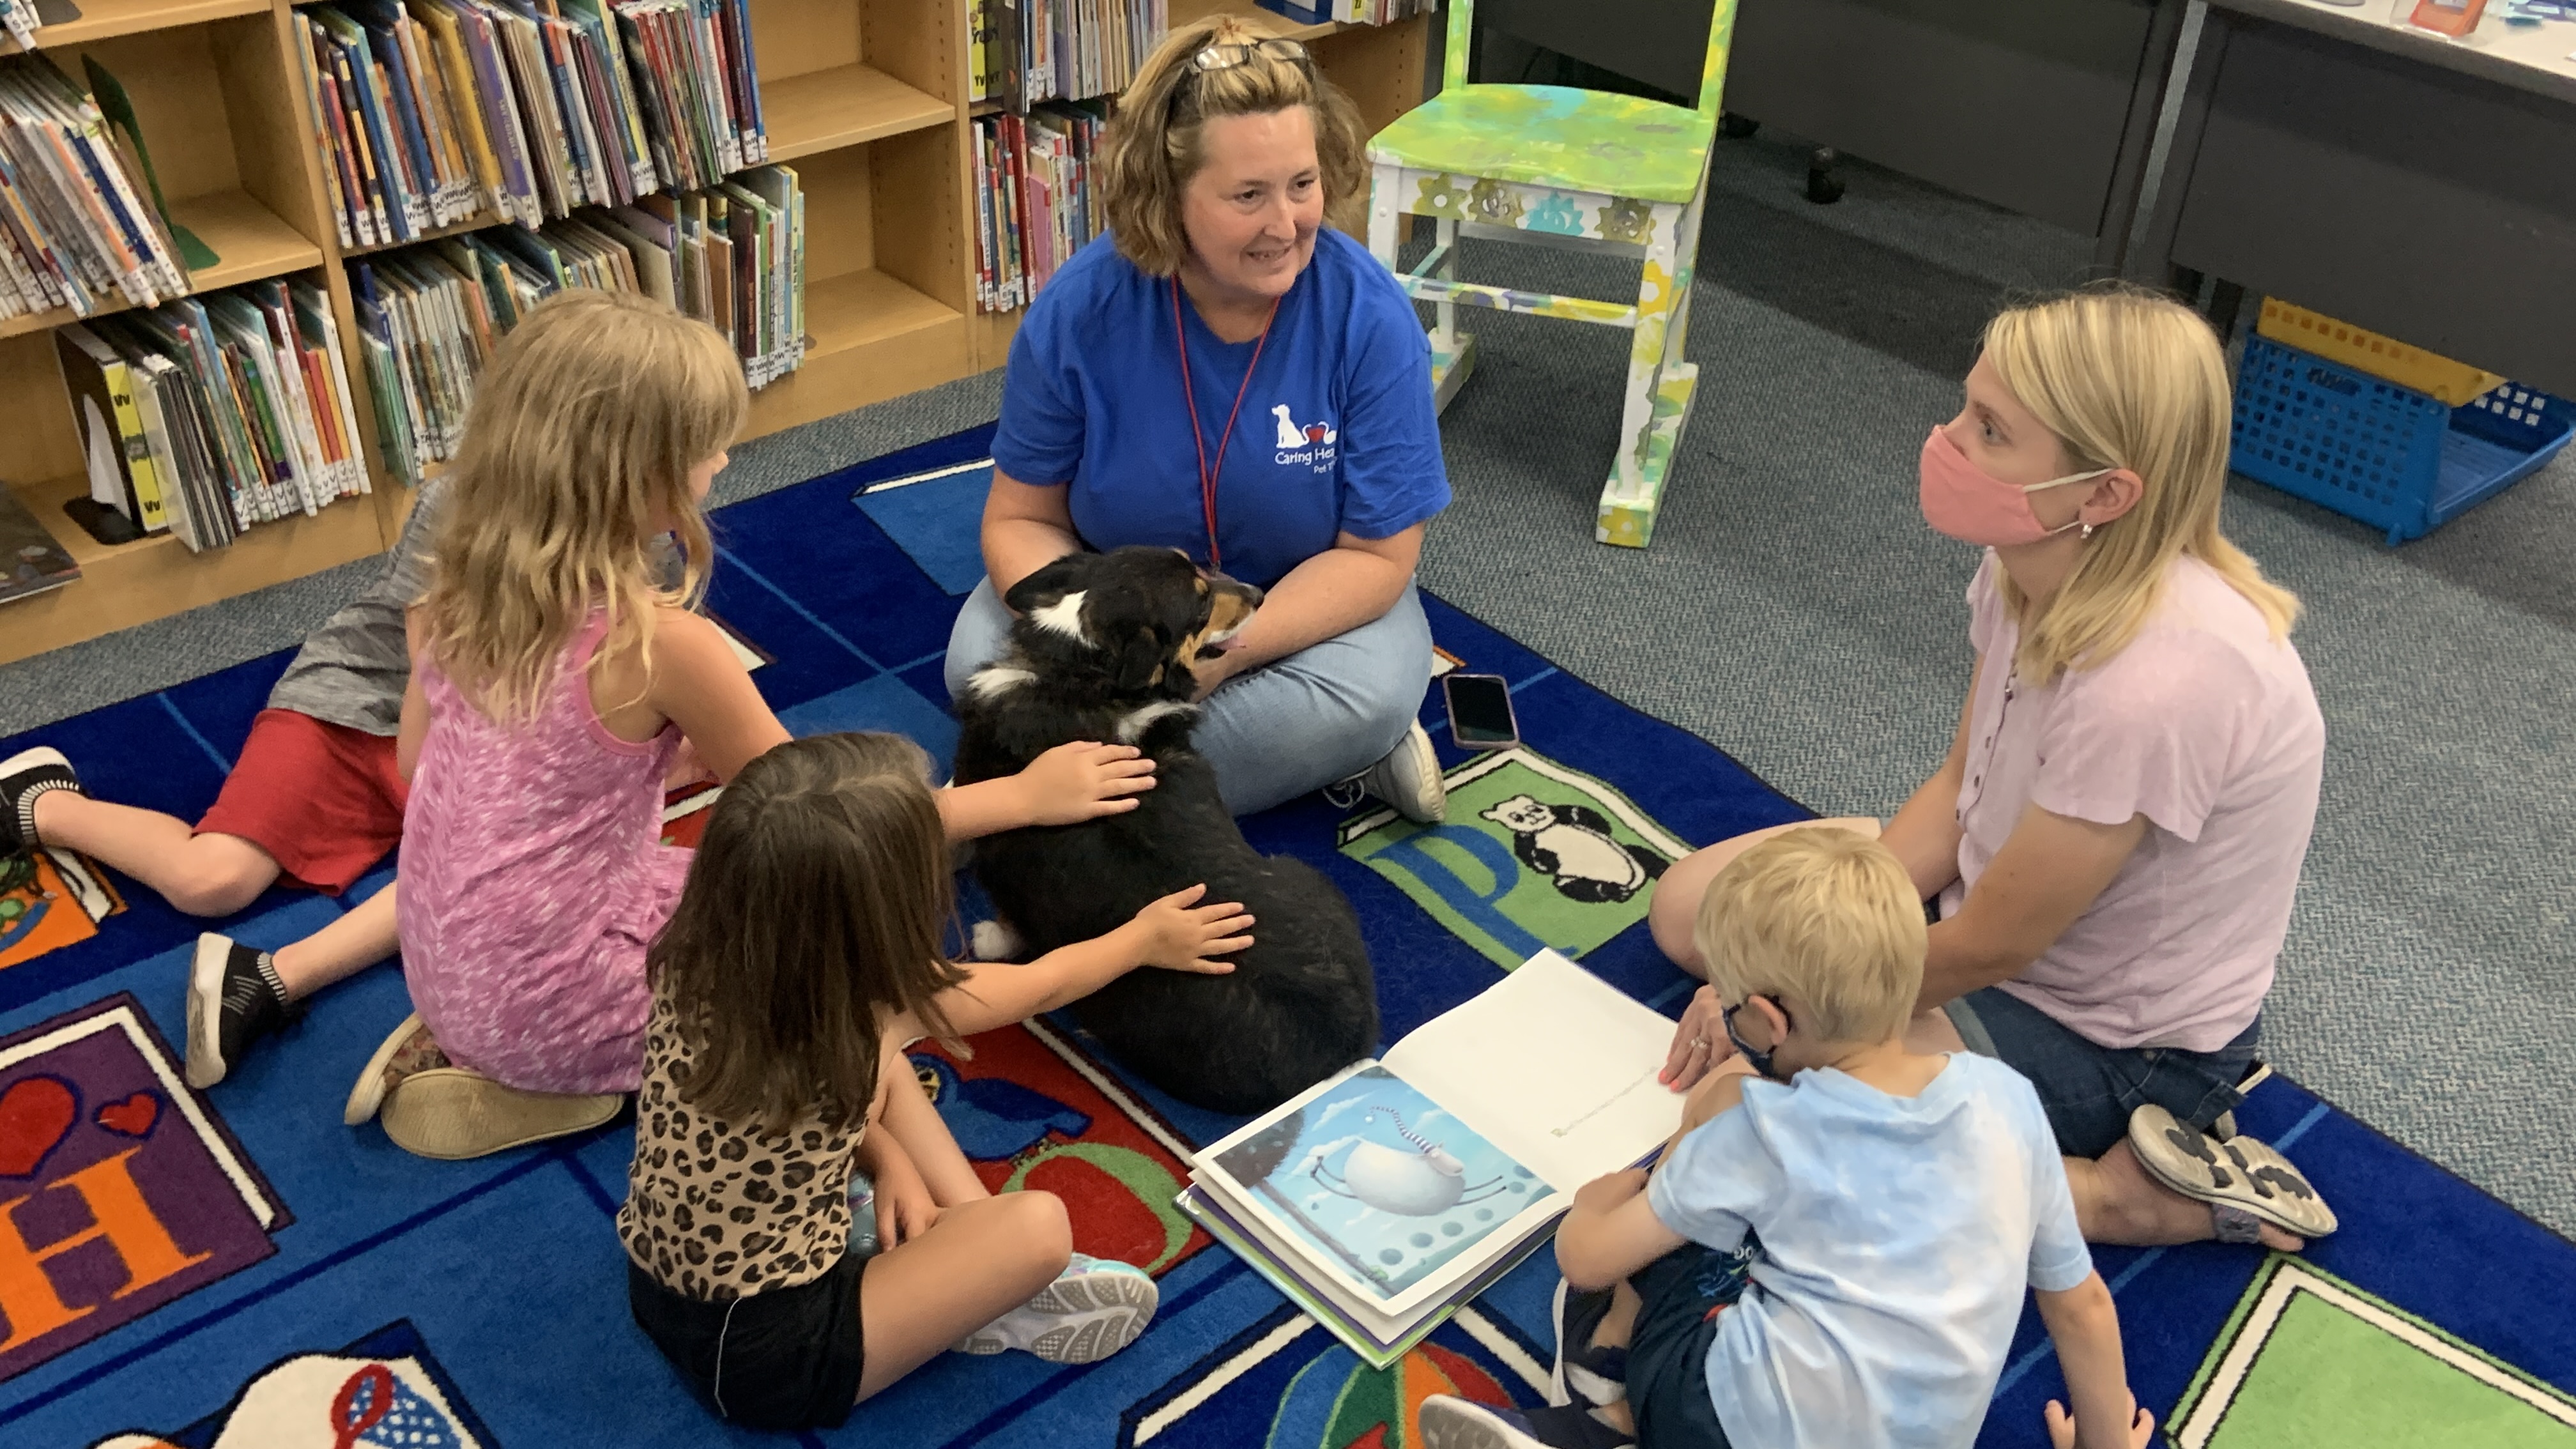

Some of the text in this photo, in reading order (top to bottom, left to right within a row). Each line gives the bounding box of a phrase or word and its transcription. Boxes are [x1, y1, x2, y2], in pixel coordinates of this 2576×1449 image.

[1275, 447, 1335, 466] Caring Hea
[1314, 464, 1327, 474] Pet
[1364, 824, 1580, 961] P
[0, 1144, 215, 1354] H
